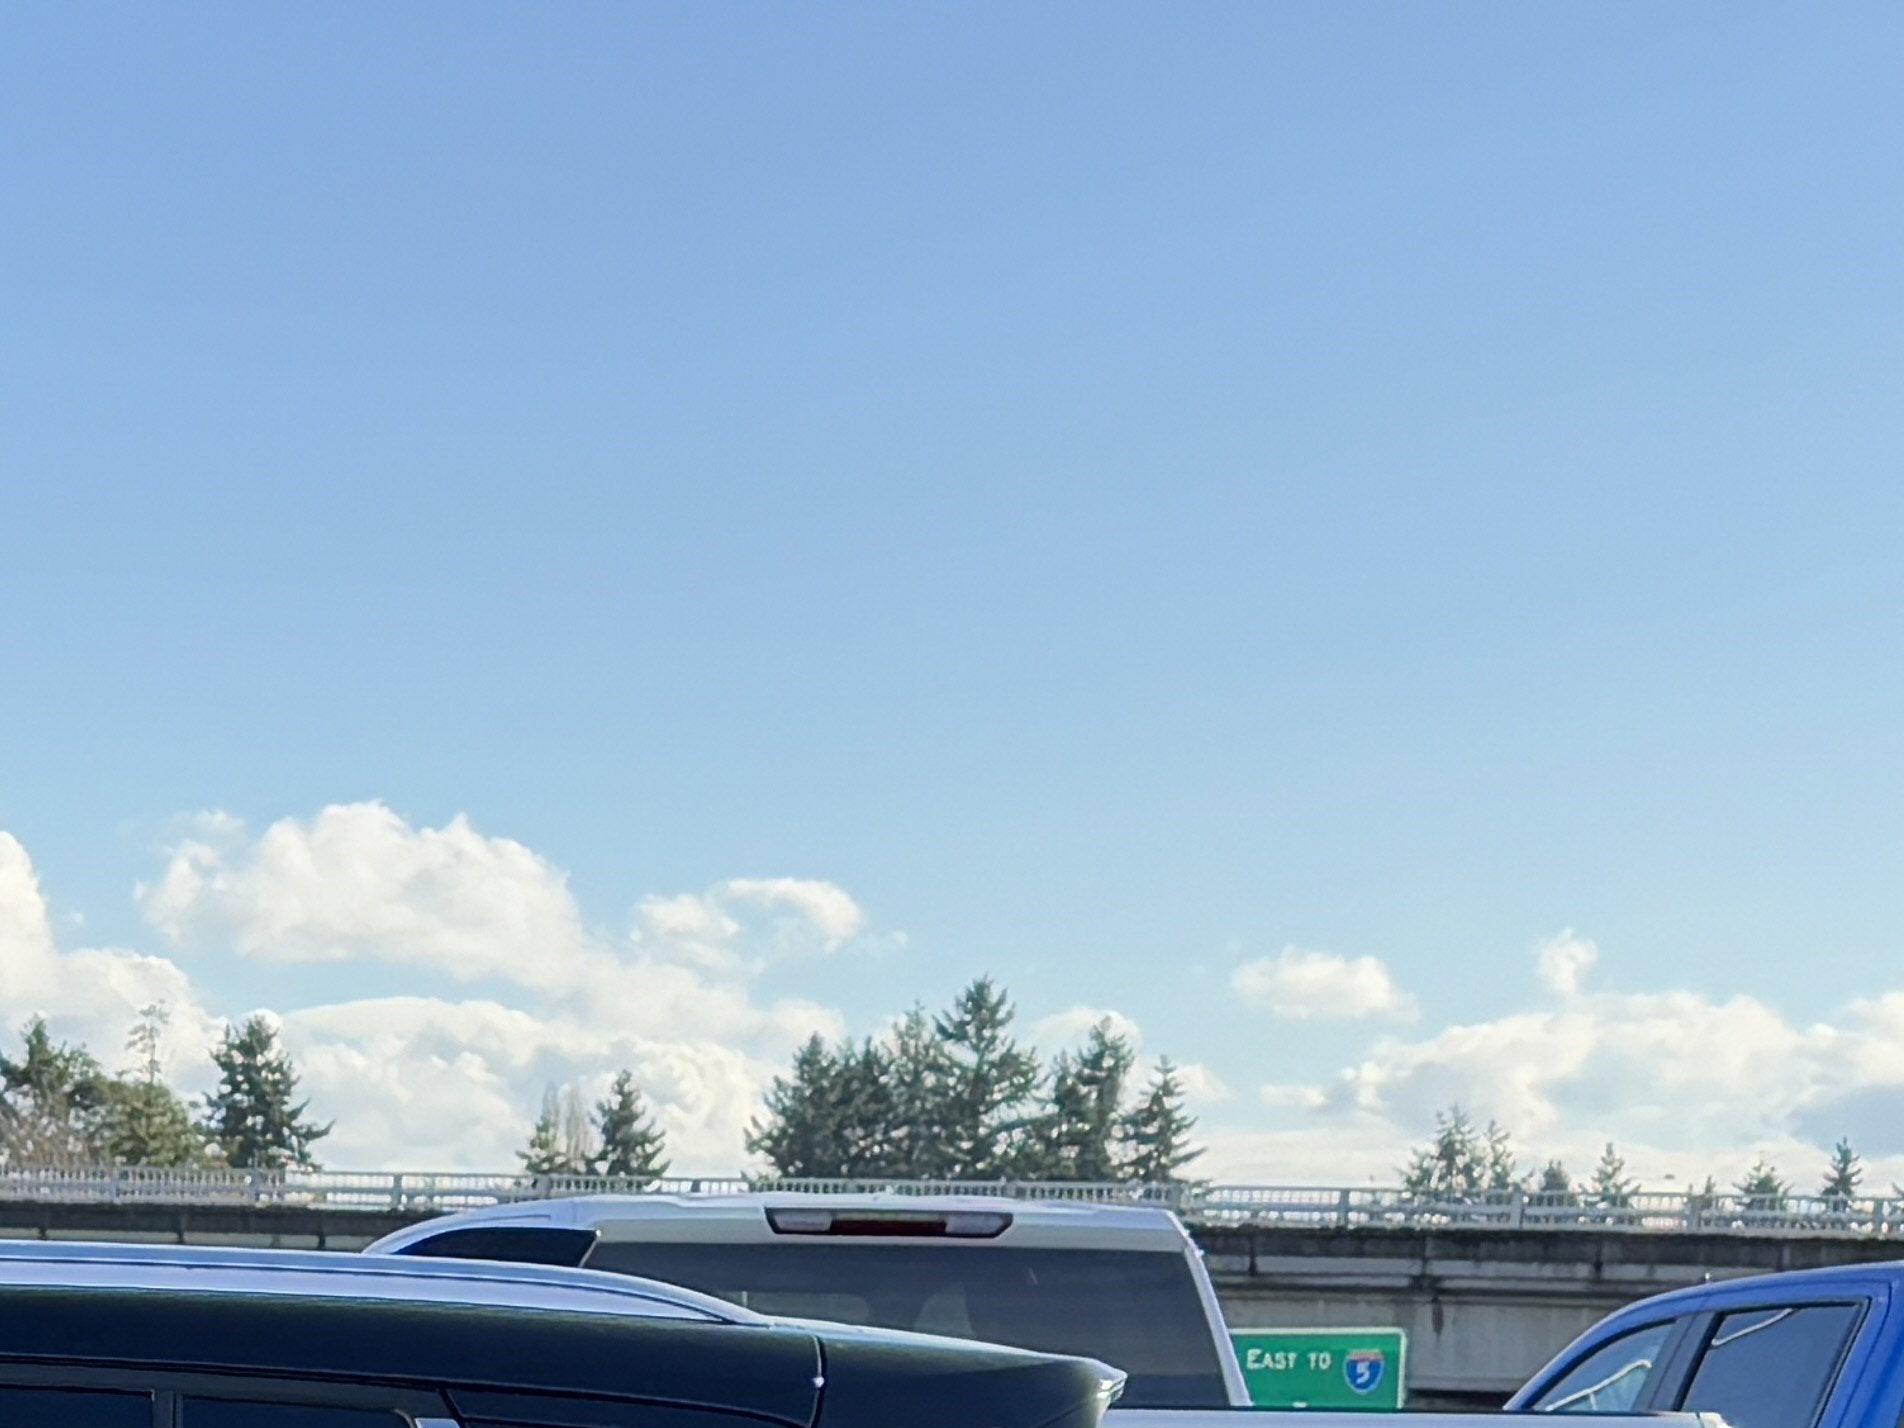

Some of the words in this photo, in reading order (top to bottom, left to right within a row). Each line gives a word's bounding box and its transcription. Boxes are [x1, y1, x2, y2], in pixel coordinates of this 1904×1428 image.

[1246, 1348, 1297, 1370] EAST
[1308, 1352, 1332, 1369] TO
[1356, 1362, 1371, 1384] 5
